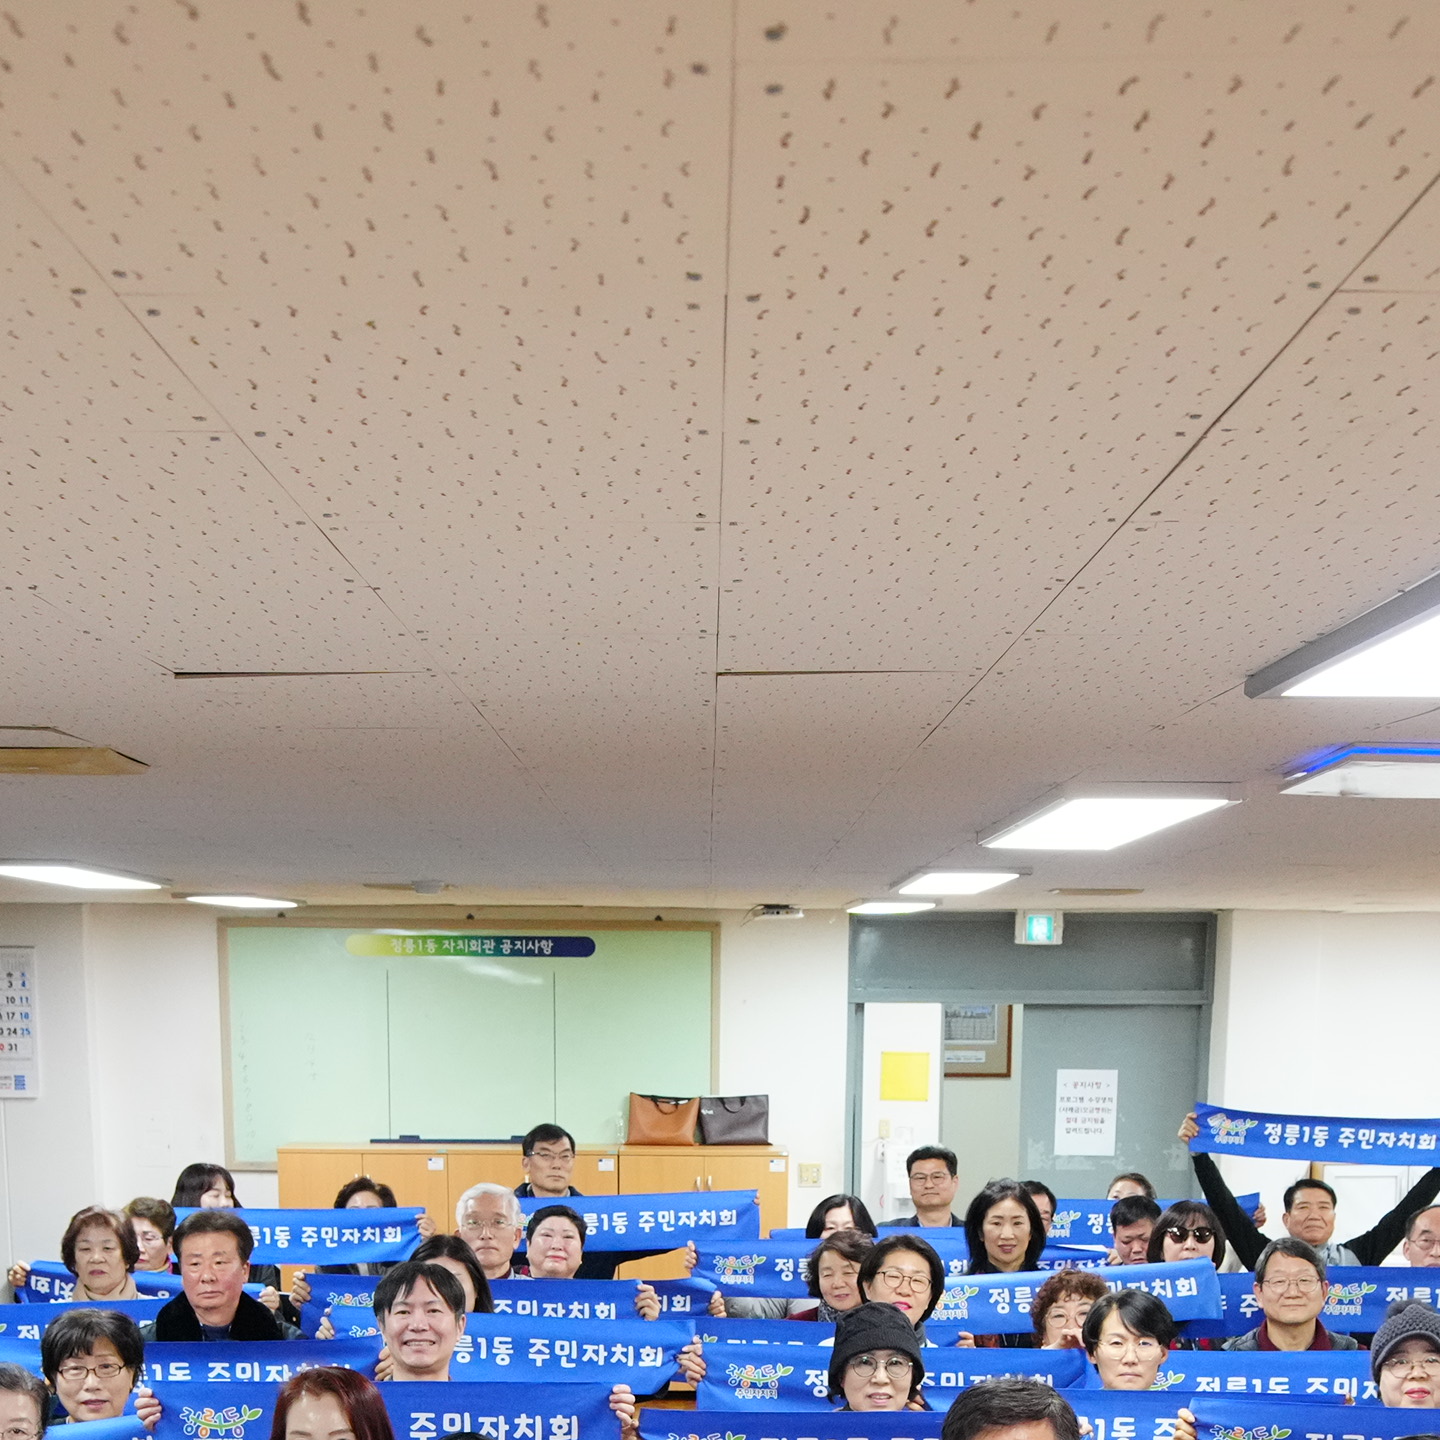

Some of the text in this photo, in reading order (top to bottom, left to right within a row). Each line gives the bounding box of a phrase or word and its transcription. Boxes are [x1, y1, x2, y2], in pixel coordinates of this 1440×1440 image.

[391, 939, 554, 955] 정릉1동 자치회관 공지사항
[1264, 1124, 1328, 1147] 정릉1동
[1339, 1128, 1436, 1149] 주민자치회
[584, 1210, 736, 1235] 릉1동 주민자치회
[302, 1227, 401, 1247] 주민자치회
[453, 1335, 663, 1367] 릉1동 주민자치회
[179, 1405, 246, 1440] 정릉1동
